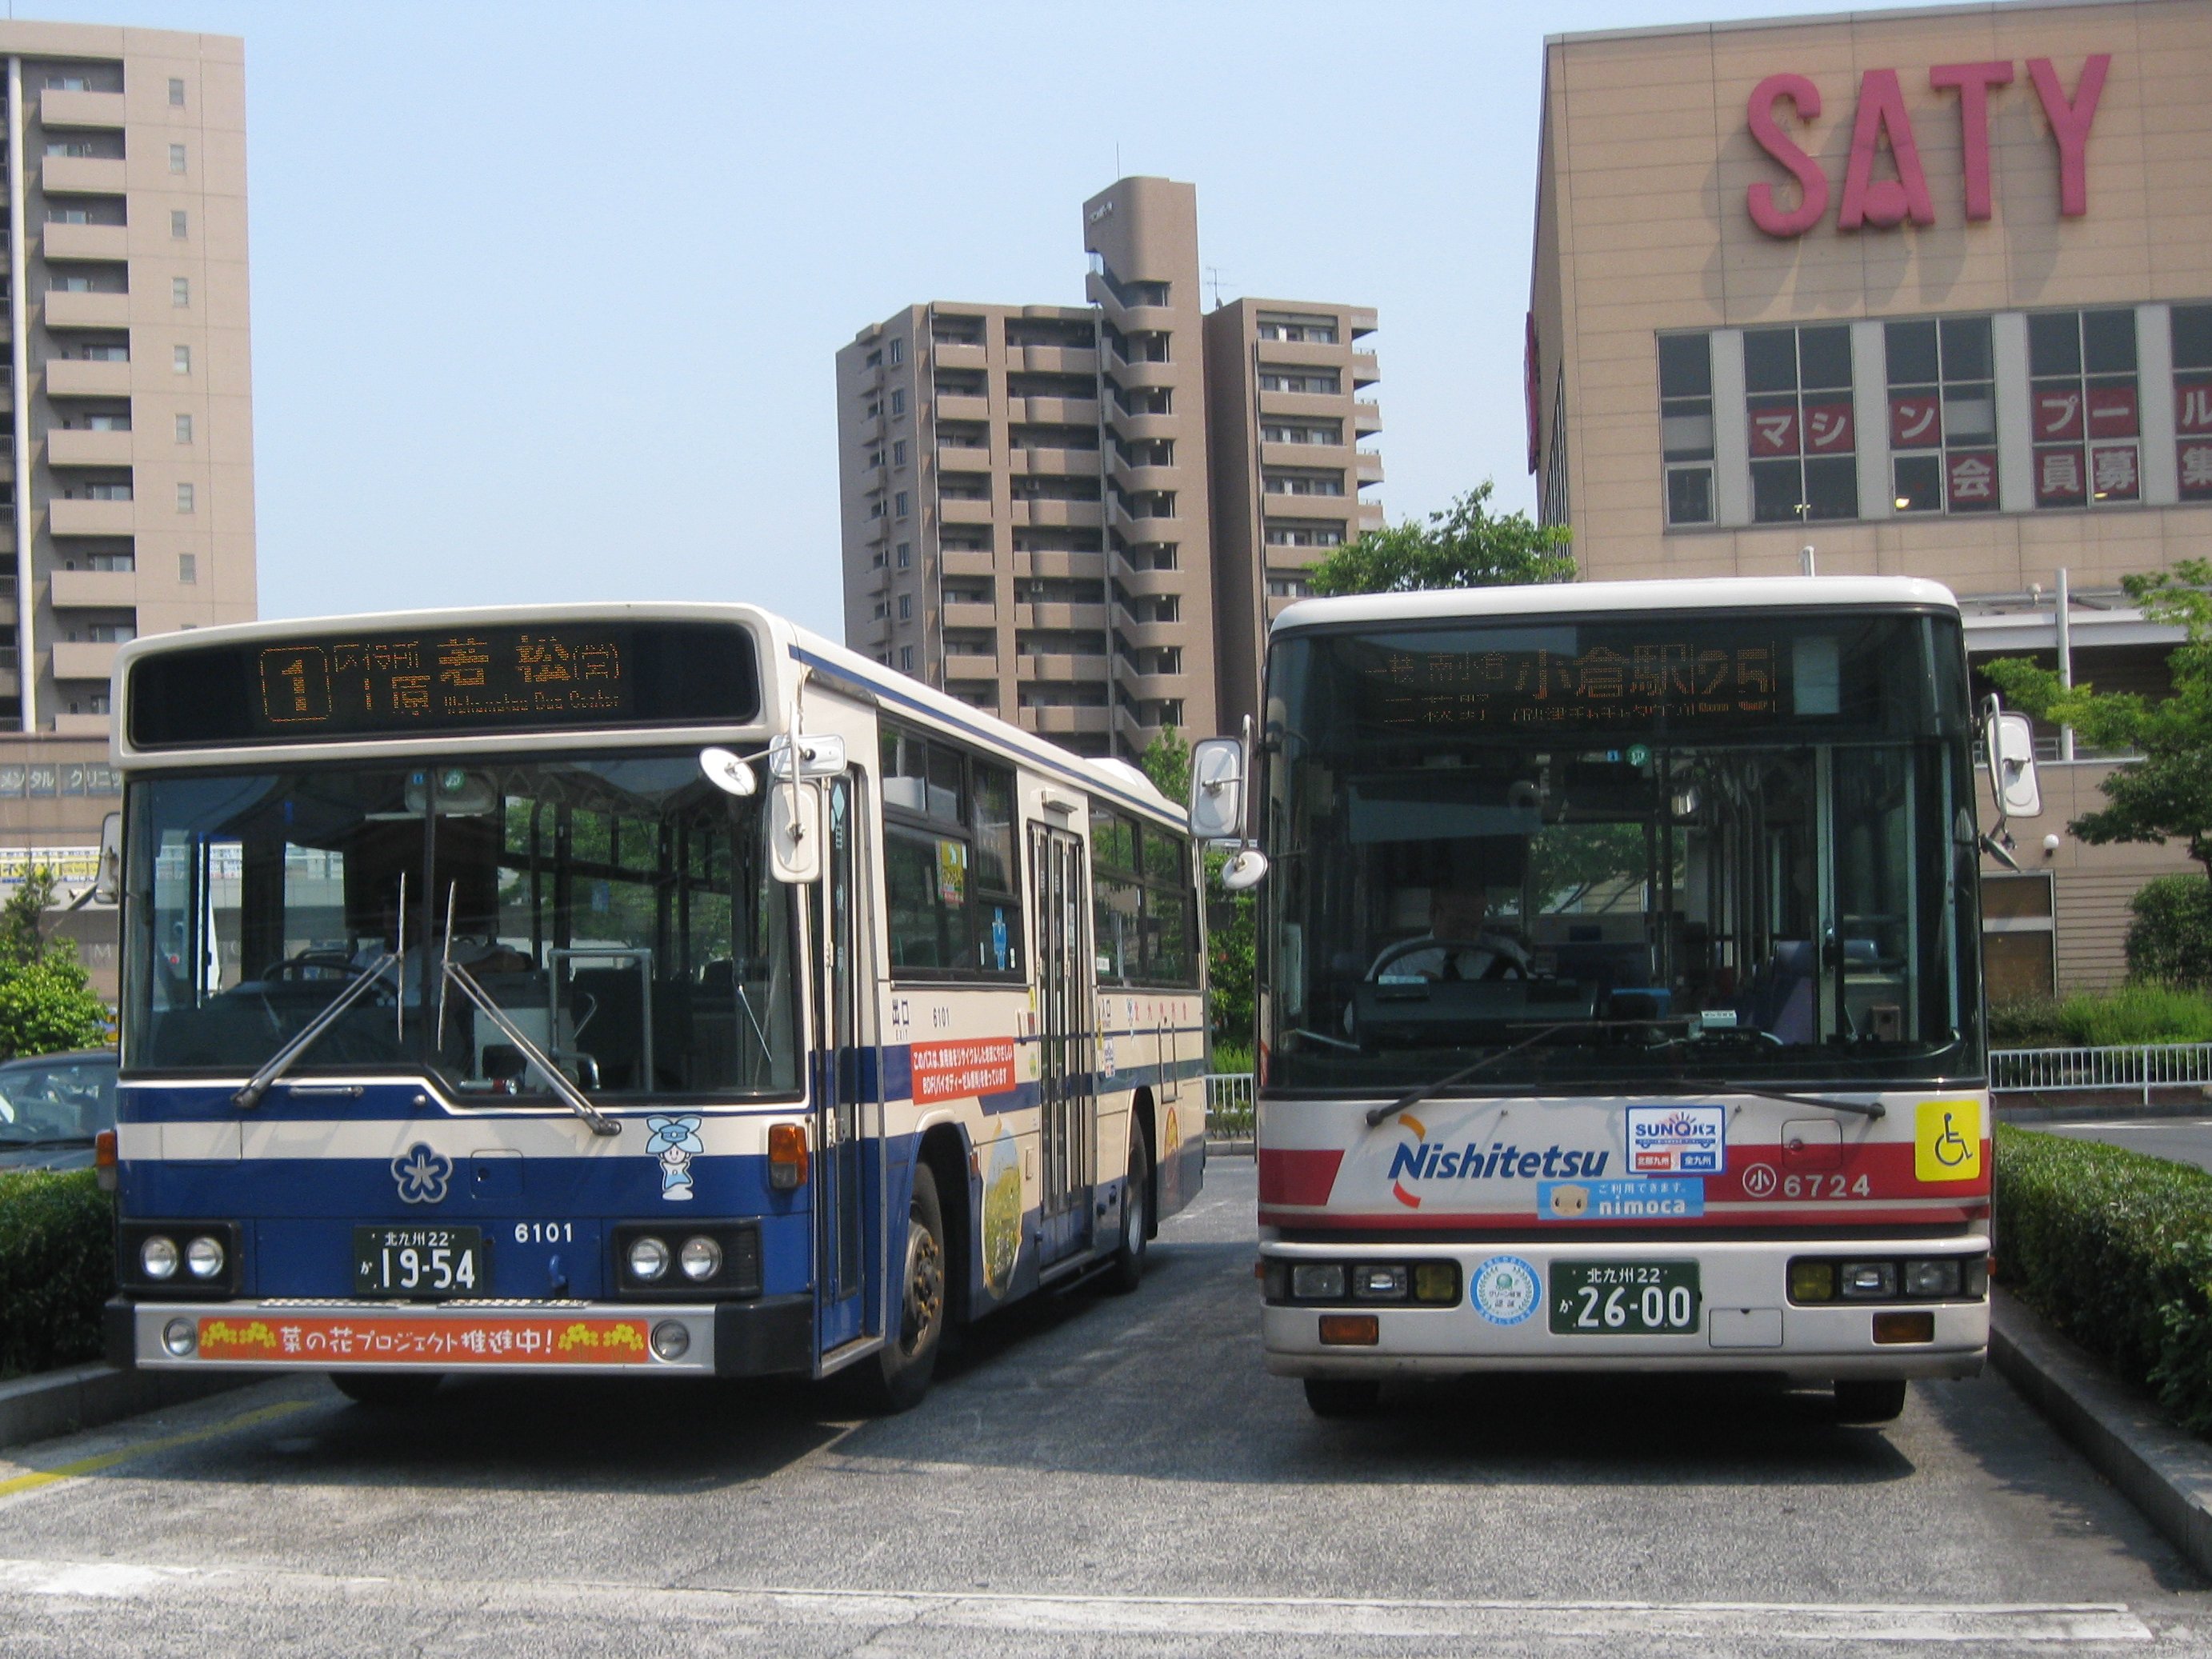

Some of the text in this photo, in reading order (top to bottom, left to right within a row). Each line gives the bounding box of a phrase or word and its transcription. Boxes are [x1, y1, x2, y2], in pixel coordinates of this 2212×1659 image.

[1746, 54, 2112, 238] SATY
[1756, 399, 1934, 449] マシン
[281, 658, 308, 712] 1
[892, 999, 910, 1025] 出口
[933, 1007, 950, 1029] 6101
[1387, 1141, 1609, 1181] Nishitetsu
[1599, 1194, 1686, 1215] nimoca
[1783, 1173, 1870, 1197] 6724
[514, 1223, 573, 1244] 6101
[382, 1248, 475, 1289] 19-54
[1577, 1285, 1690, 1328] 26-00
